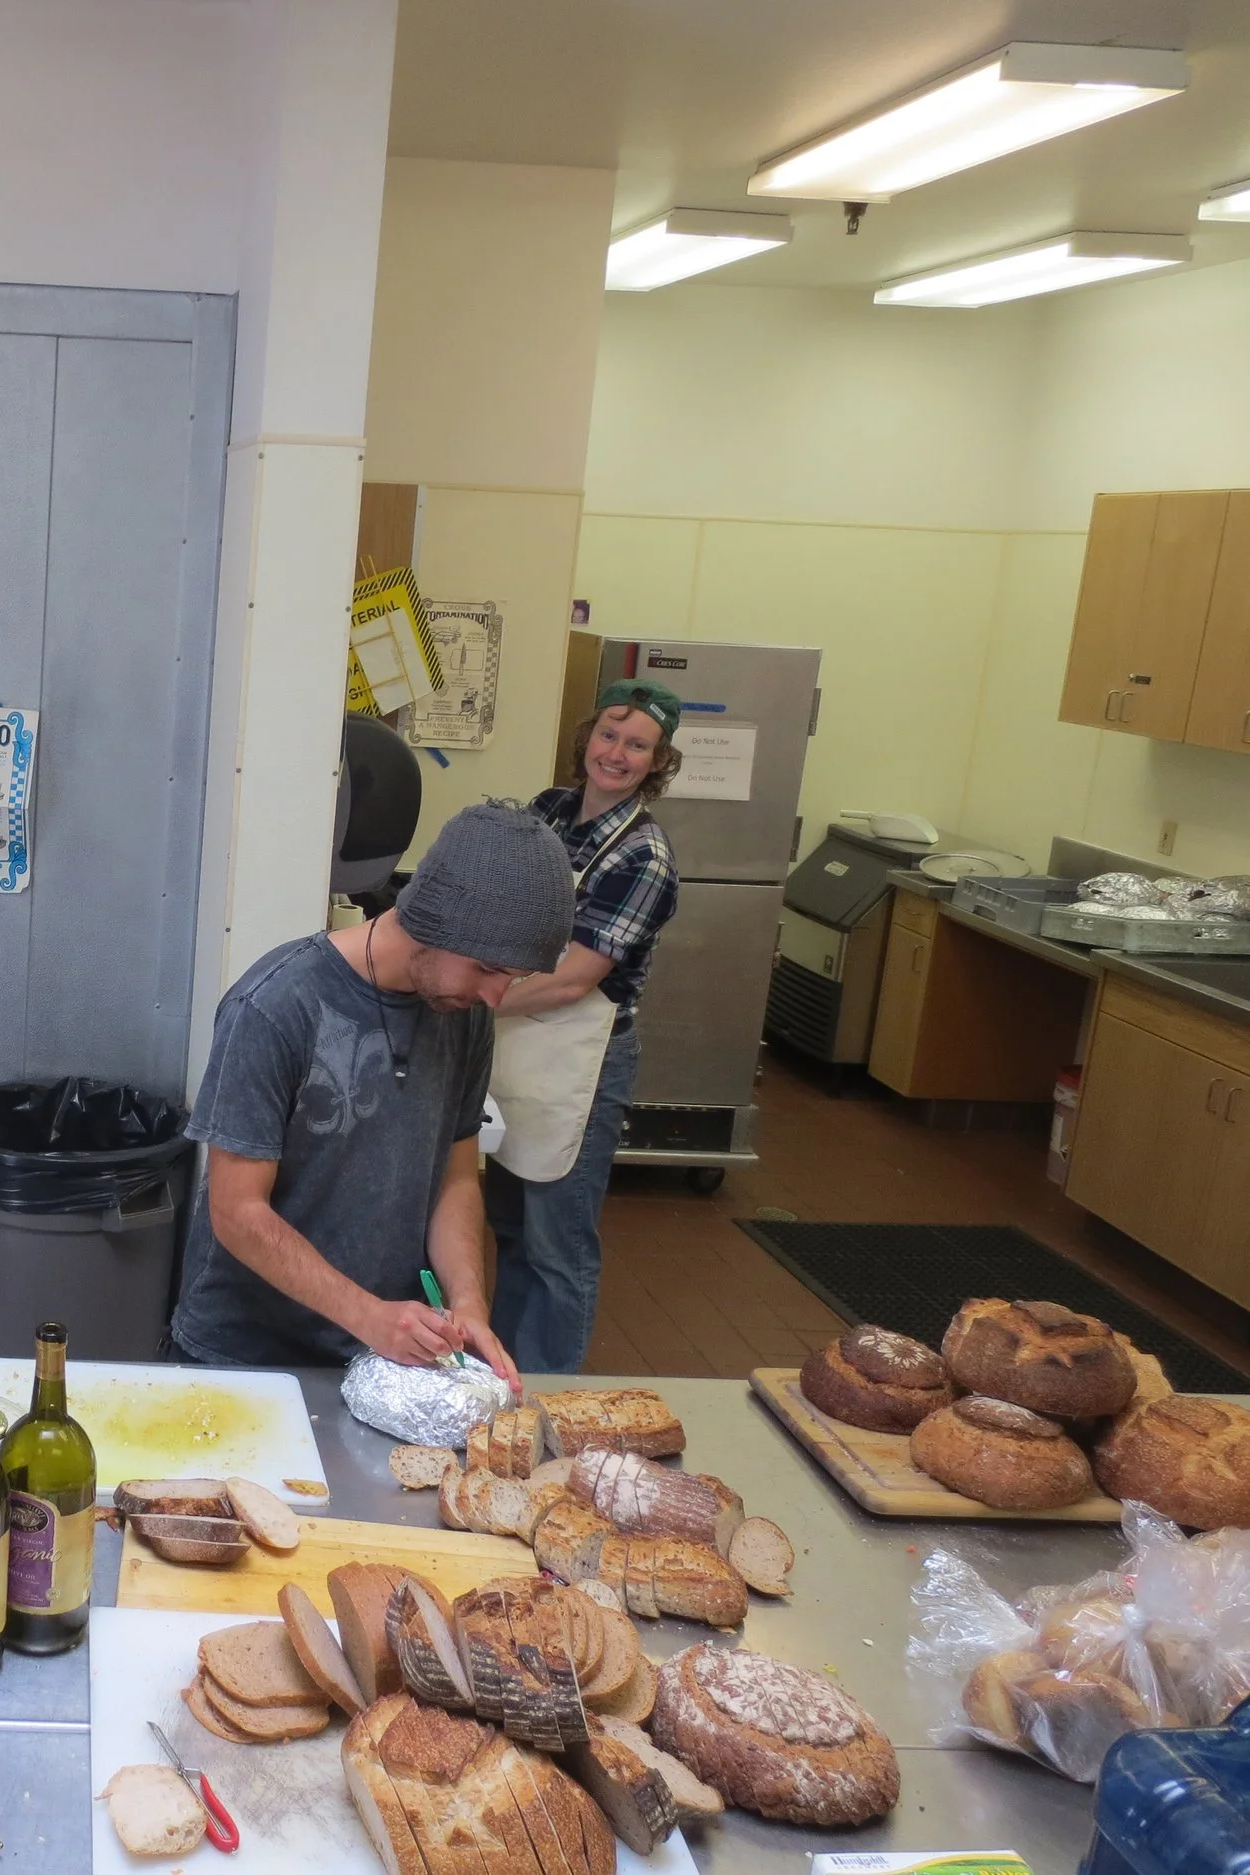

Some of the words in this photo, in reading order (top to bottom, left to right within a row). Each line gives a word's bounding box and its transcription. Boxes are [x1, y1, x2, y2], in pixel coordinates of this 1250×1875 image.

[350, 600, 401, 628] TERIAL
[426, 611, 489, 630] CONTAMINATION
[703, 737, 715, 745] Not
[12, 1545, 62, 1562] ganic
